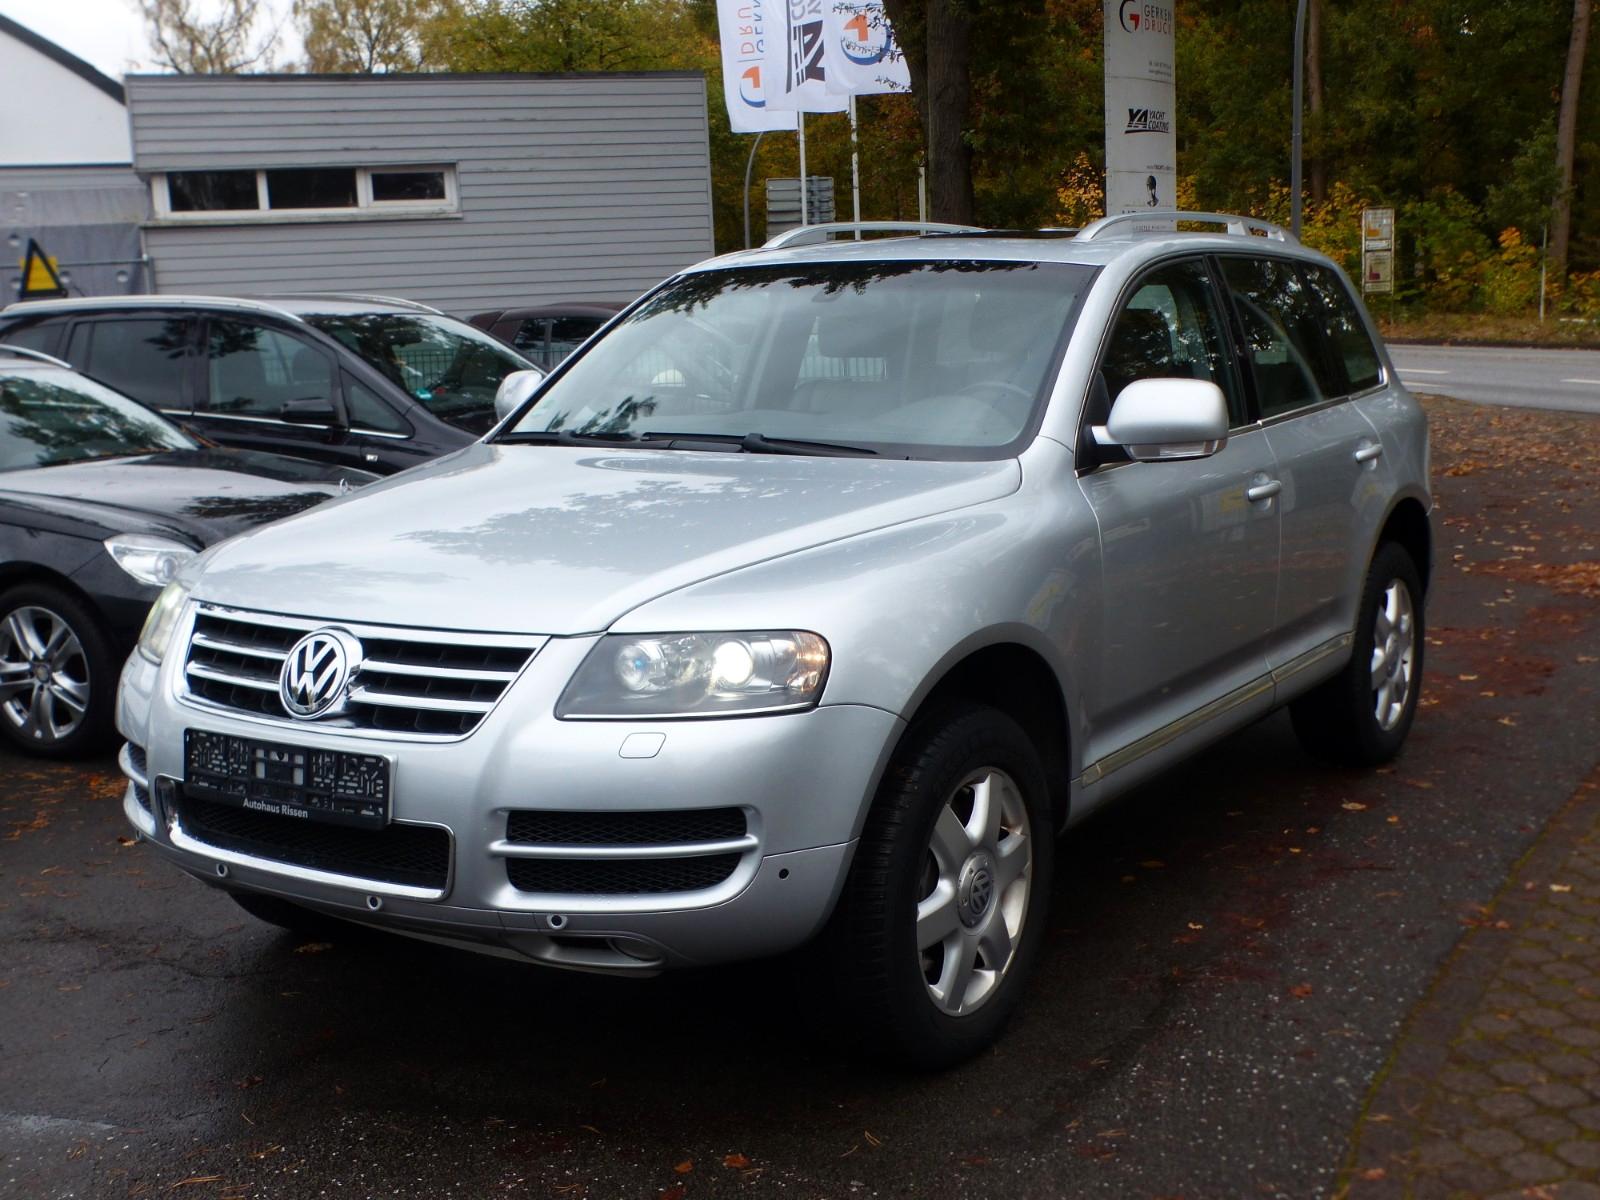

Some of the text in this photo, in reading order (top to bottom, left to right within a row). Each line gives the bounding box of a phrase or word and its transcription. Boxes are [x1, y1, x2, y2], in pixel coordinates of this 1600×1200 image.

[1149, 110, 1166, 120] YACHT
[1148, 120, 1169, 131] COATING
[243, 797, 308, 818] Autohaus Rissen
